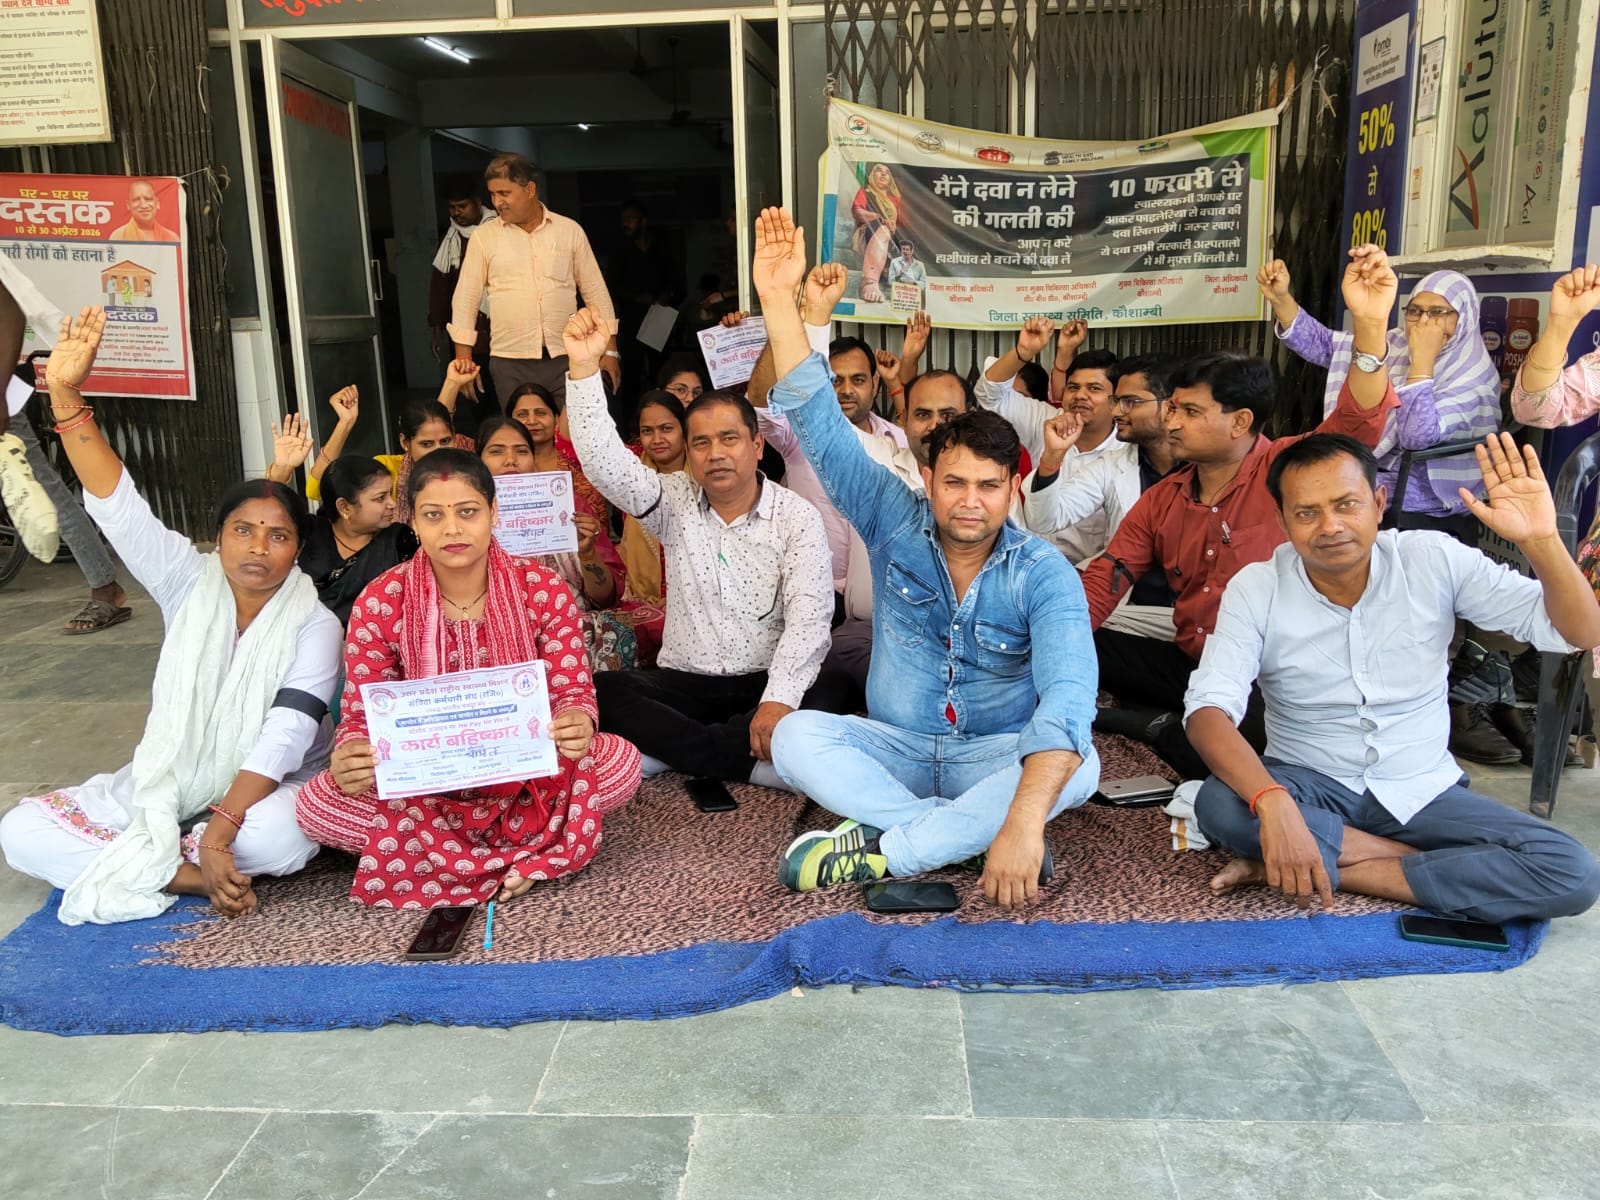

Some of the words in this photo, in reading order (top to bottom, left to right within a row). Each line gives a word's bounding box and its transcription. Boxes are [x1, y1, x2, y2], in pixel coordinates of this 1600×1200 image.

[1358, 100, 1395, 154] 50%
[1109, 178, 1136, 198] 10
[1144, 166, 1214, 194] फरवरी
[1221, 160, 1244, 186] से
[1368, 164, 1378, 196] से
[20, 188, 37, 198] घर
[52, 190, 70, 200] घर
[72, 190, 89, 200] पर
[933, 174, 969, 198] मैंने
[973, 181, 1012, 201] दवा
[1016, 181, 1035, 199] न
[1039, 174, 1078, 199] लेने
[1197, 190, 1226, 203] आपके
[1228, 192, 1244, 202] घर
[0, 197, 114, 225] दस्तक
[952, 205, 980, 227] की
[984, 205, 1042, 229] गलती
[1046, 205, 1075, 228] की
[1104, 215, 1134, 226] आकर
[1136, 209, 1187, 224] फाइलेरिया
[1189, 206, 1198, 218] से
[1200, 206, 1226, 217] बचाव
[1228, 204, 1242, 216] की
[28, 225, 36, 235] से
[39, 228, 49, 236] 30
[52, 226, 78, 236] अप्रैल
[81, 228, 100, 237] 2026
[1112, 228, 1130, 239] दवा
[1352, 208, 1386, 250] 80%
[1018, 238, 1040, 249] आप
[1042, 238, 1052, 249] न
[1054, 236, 1072, 248] करें
[1100, 245, 1110, 256] ये
[1112, 245, 1130, 256] दवा
[1133, 240, 1155, 253] सभी
[1156, 239, 1192, 251] सरकारी
[25, 244, 49, 260] रोगों
[52, 245, 68, 260] को
[72, 249, 103, 262] हराना
[108, 246, 117, 262] है
[980, 252, 991, 264] से
[994, 252, 1020, 264] बचने
[1023, 252, 1038, 264] की
[1040, 254, 1058, 266] दवा
[1154, 254, 1166, 266] भी
[1194, 250, 1225, 264] मिलती
[1072, 281, 1097, 291] अधिकारी
[106, 311, 156, 321] दस्तक
[989, 310, 1018, 322] जिला
[1112, 304, 1162, 320] कौशाम्बी
[506, 516, 554, 528] बहिष्कार
[400, 689, 416, 698] उत्तर
[419, 686, 438, 696] प्रदेश
[440, 684, 460, 694] राष्ट्रीय
[434, 694, 462, 704] कर्मचारी
[464, 692, 478, 700] संघ
[399, 732, 441, 752] कार्य
[444, 724, 520, 748] बहिष्कार
